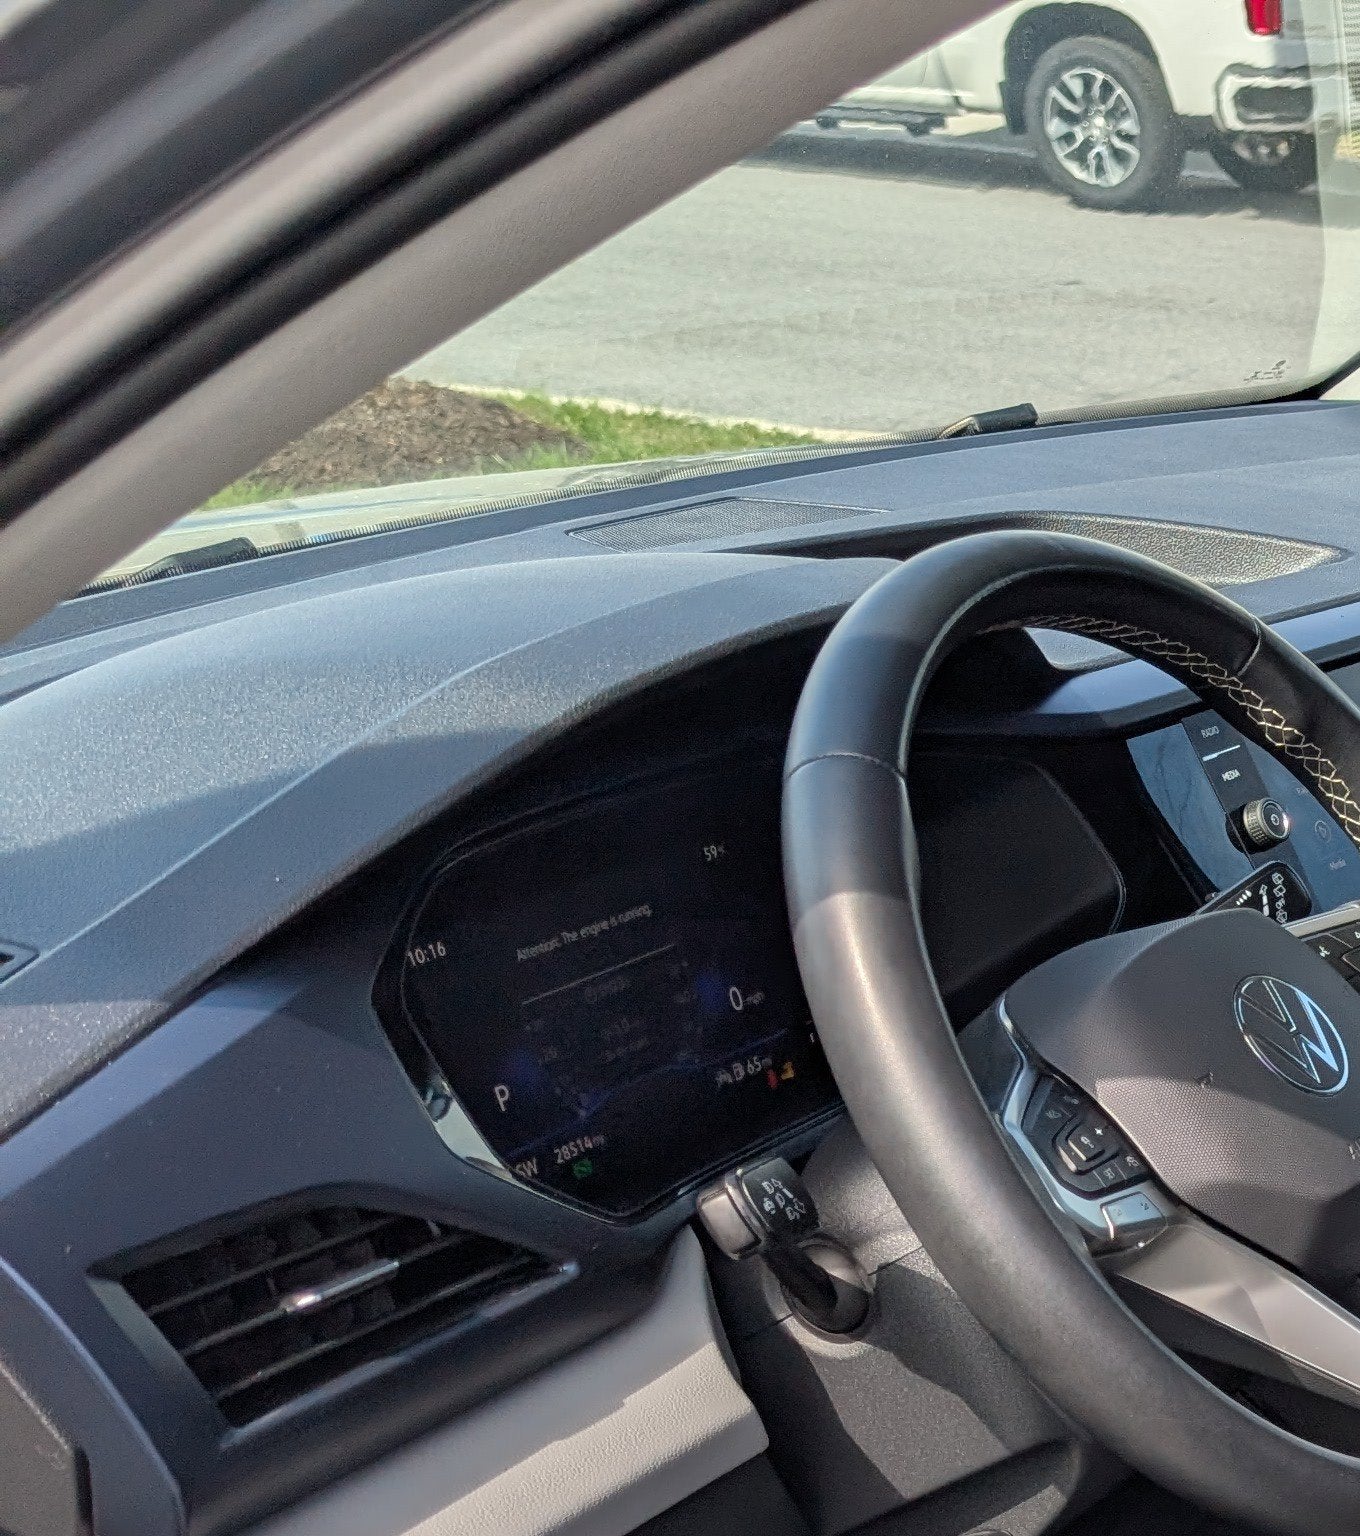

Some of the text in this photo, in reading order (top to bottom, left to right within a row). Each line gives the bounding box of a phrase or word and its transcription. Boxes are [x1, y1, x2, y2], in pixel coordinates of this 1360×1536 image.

[1201, 725, 1219, 739] RADIO
[1221, 768, 1241, 782] MEDIA
[405, 941, 447, 967] 10:16
[729, 986, 743, 1011] 0
[747, 1056, 761, 1074] 65
[494, 1084, 510, 1112] P
[553, 1135, 593, 1164] 28514
